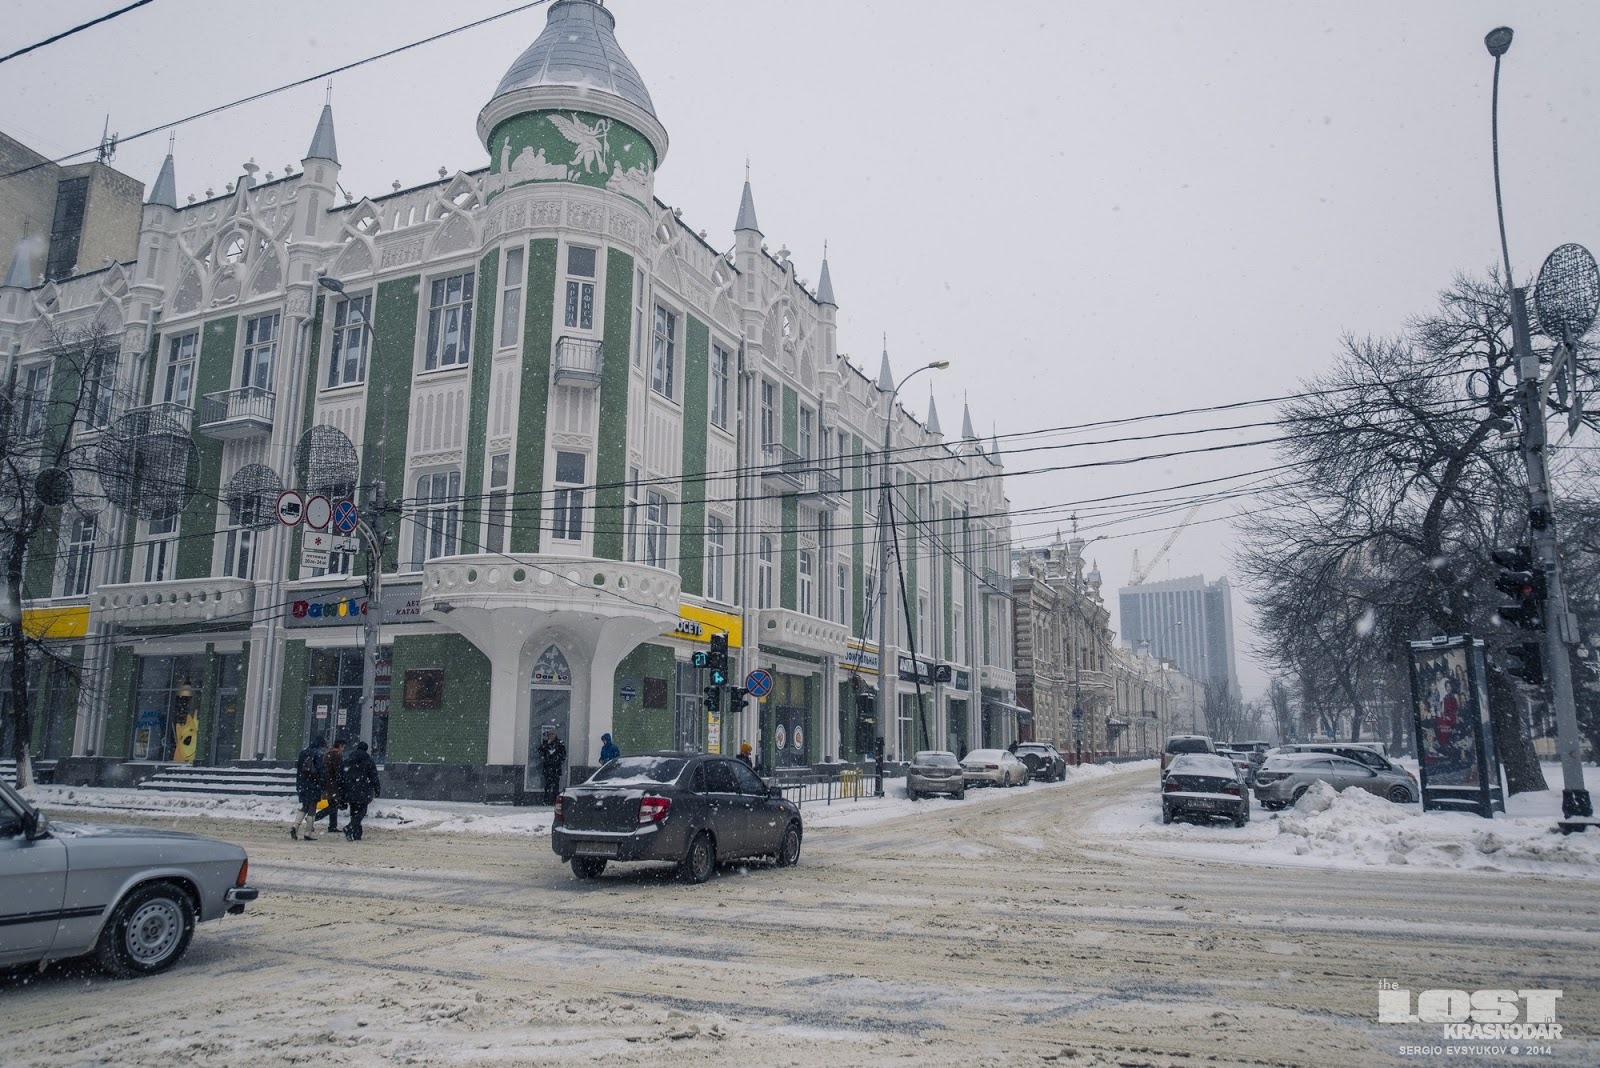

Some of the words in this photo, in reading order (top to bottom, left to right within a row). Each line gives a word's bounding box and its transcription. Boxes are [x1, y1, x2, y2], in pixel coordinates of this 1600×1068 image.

[568, 282, 576, 327] АРЕНДА
[583, 287, 592, 325] ОФИСА
[695, 653, 707, 666] 27
